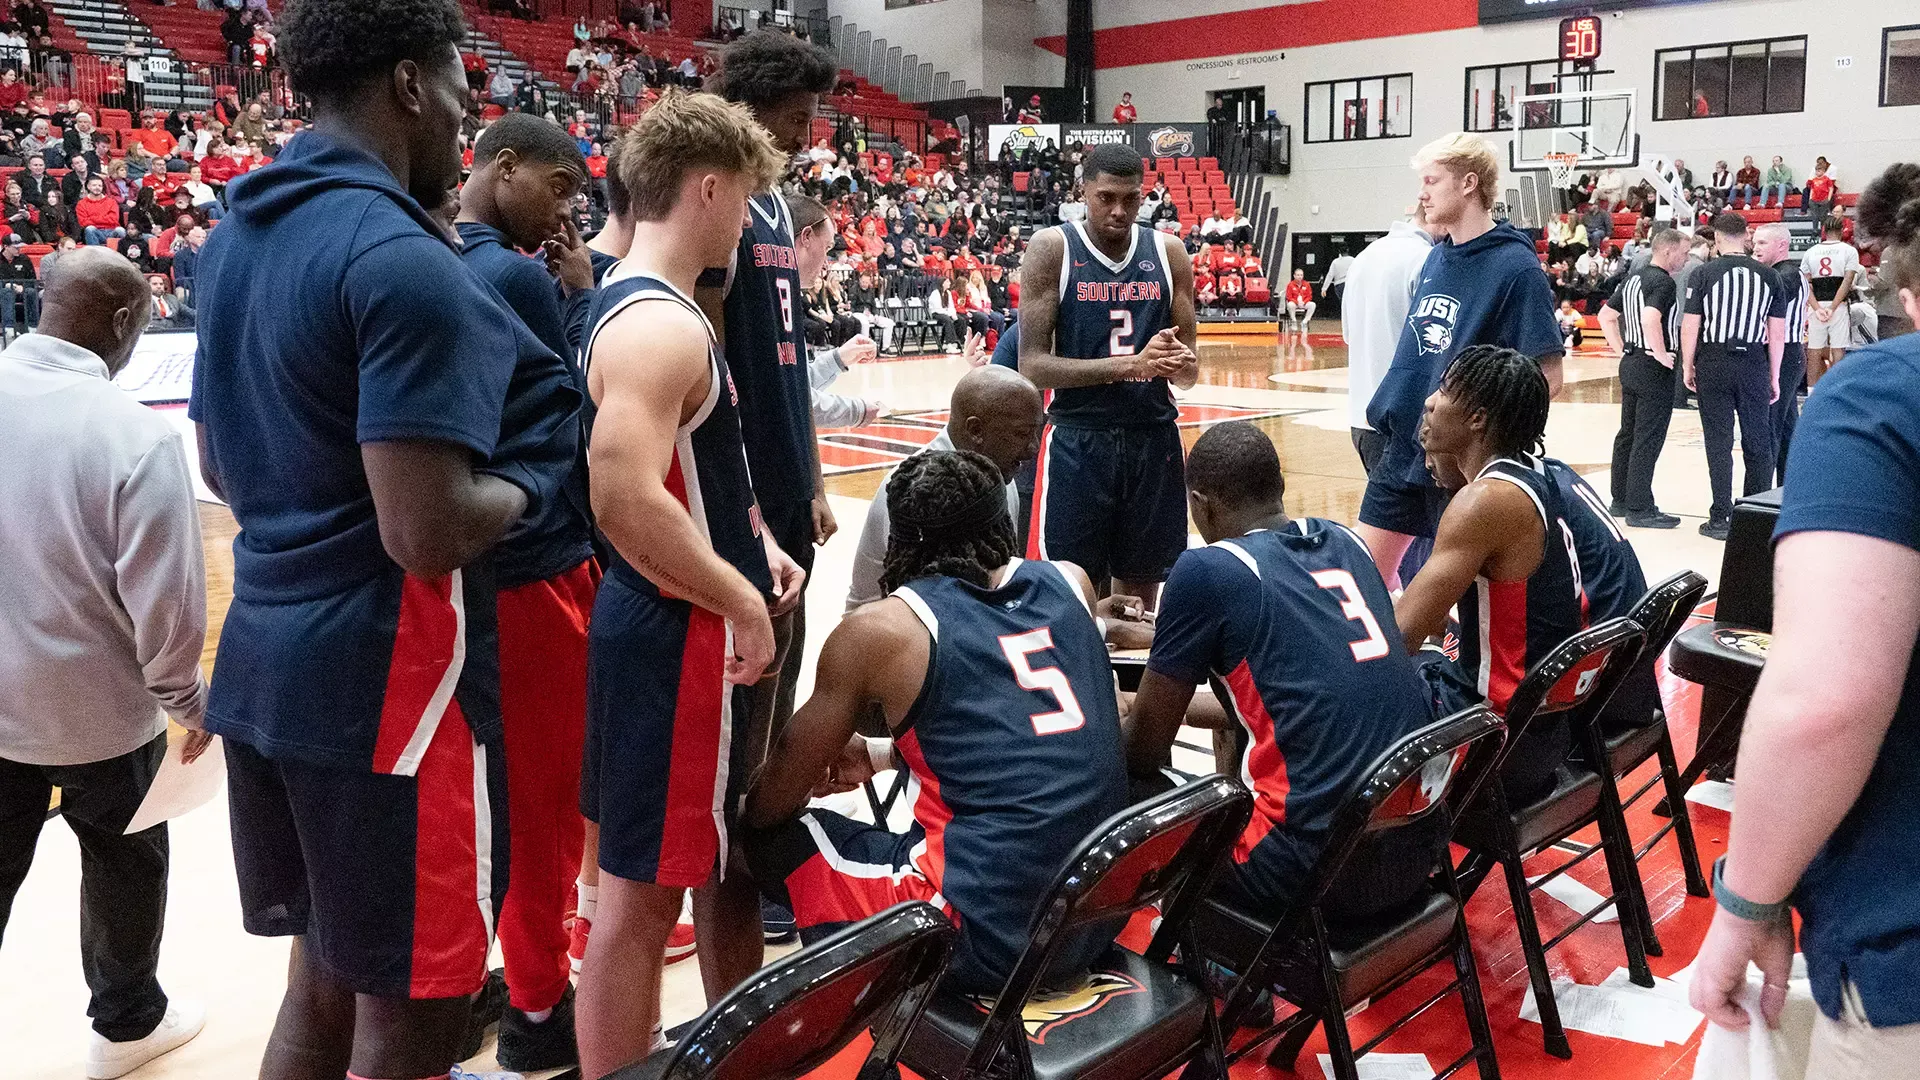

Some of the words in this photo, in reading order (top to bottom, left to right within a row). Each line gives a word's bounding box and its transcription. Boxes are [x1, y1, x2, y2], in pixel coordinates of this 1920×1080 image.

[1565, 30, 1596, 58] 30
[151, 60, 168, 70] 110
[1186, 59, 1234, 72] CONCESSIONS
[1237, 54, 1279, 66] RESTROOMS
[1837, 58, 1851, 66] 113
[1065, 135, 1123, 145] DIVISION
[1126, 135, 1130, 145] I
[1819, 257, 1833, 276] 8
[1077, 281, 1161, 301] SOUTHERN
[1416, 297, 1458, 325] USI
[1109, 309, 1135, 357] 2
[1310, 568, 1390, 663] 3
[998, 627, 1085, 737] 5
